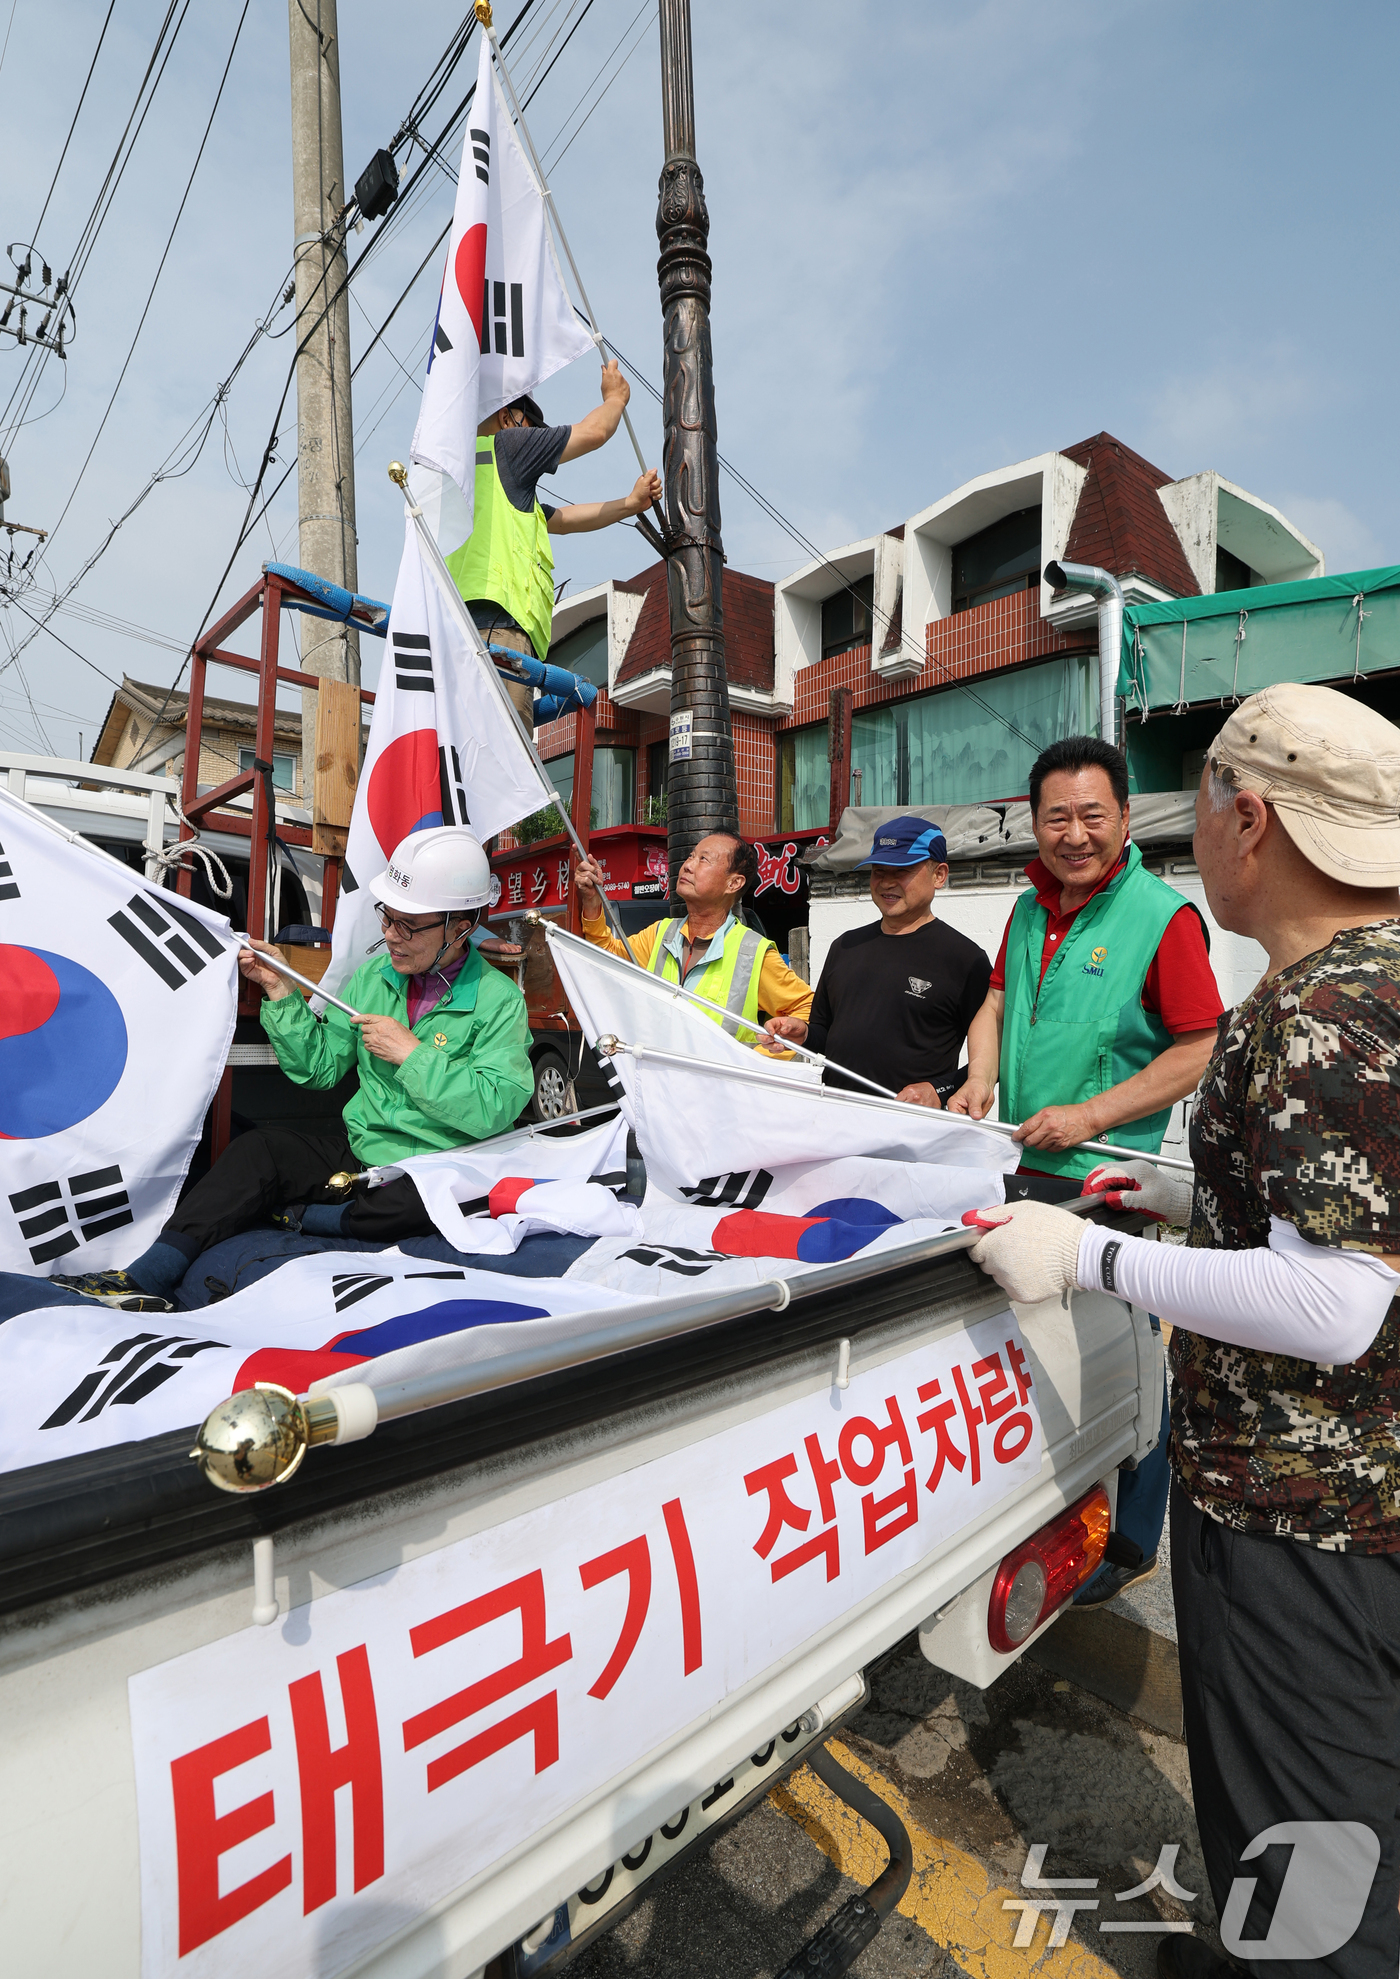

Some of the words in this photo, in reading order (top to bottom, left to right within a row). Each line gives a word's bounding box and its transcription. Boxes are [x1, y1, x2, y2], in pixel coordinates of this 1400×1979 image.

[1081, 964, 1105, 978] SMU
[1105, 1246, 1116, 1264] TOP
[170, 1497, 704, 1958] 태극기
[743, 1339, 1033, 1584] 작업차량
